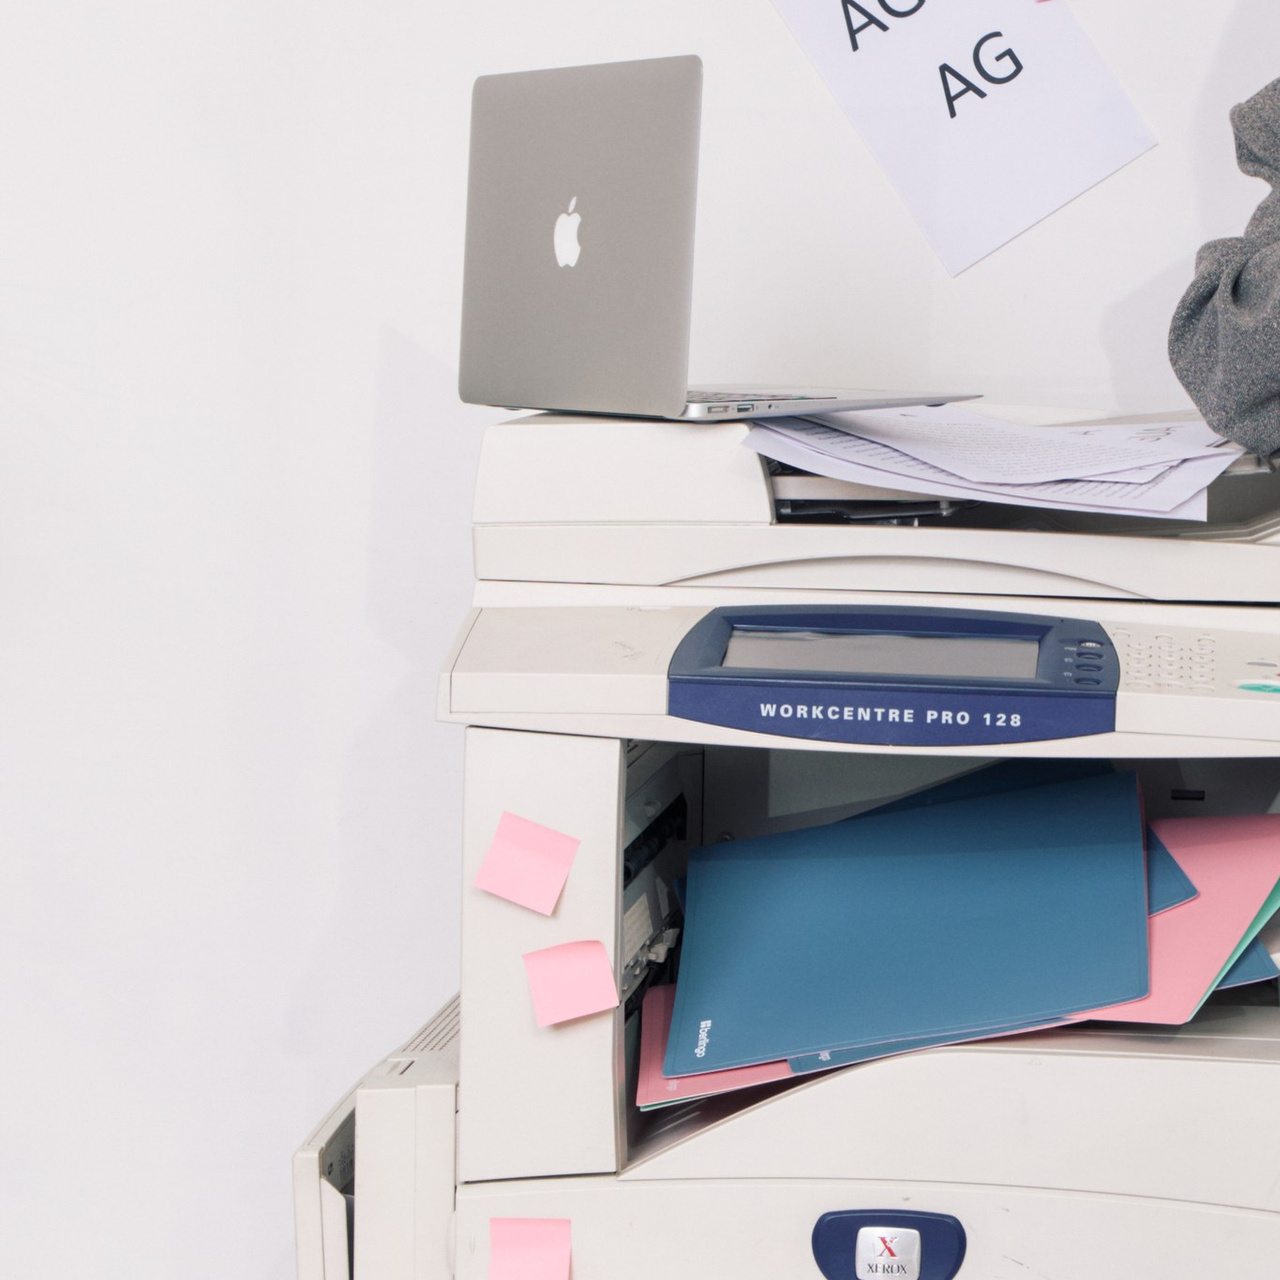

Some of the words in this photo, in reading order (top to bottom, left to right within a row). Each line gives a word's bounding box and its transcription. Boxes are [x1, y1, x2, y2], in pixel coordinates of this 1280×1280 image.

[939, 31, 1023, 119] AG
[760, 703, 914, 723] WORKCENTRE
[926, 710, 970, 725] PRO
[983, 713, 1021, 727] 128
[867, 1263, 907, 1274] XEROX
